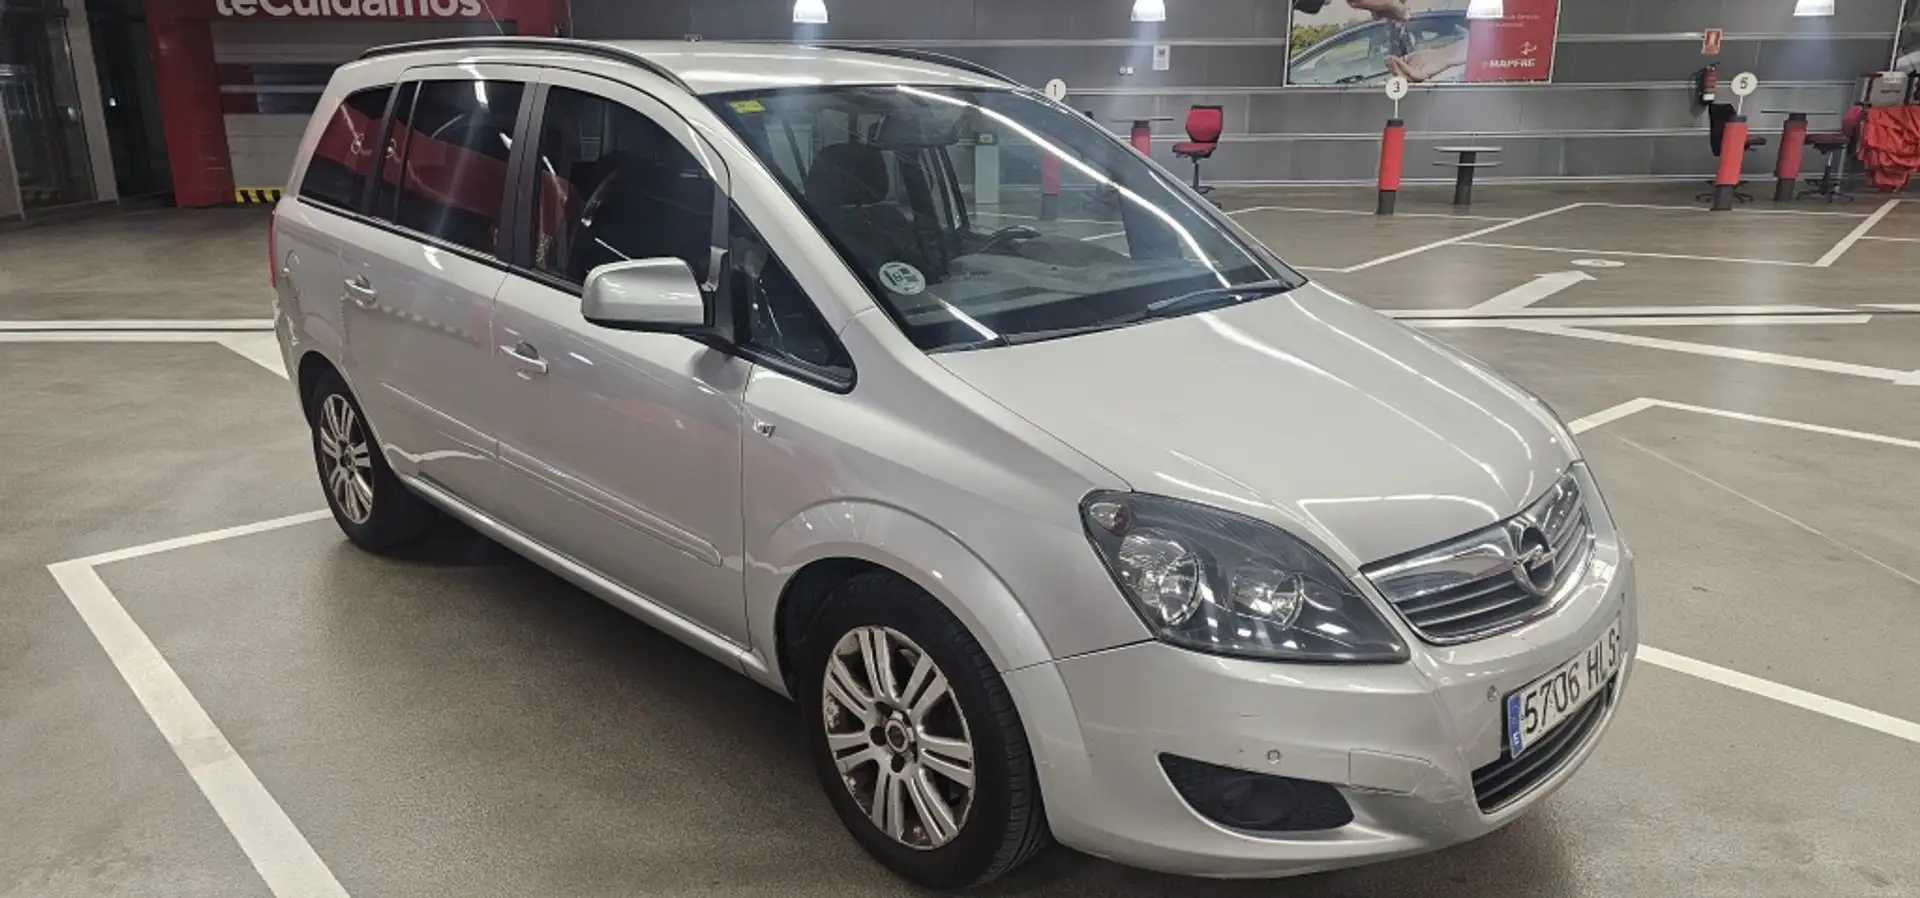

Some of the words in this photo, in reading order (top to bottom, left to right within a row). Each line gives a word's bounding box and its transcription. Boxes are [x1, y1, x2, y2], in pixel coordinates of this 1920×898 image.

[1392, 80, 1400, 93] 3
[1740, 77, 1748, 89] 5
[1524, 662, 1581, 734] 5706
